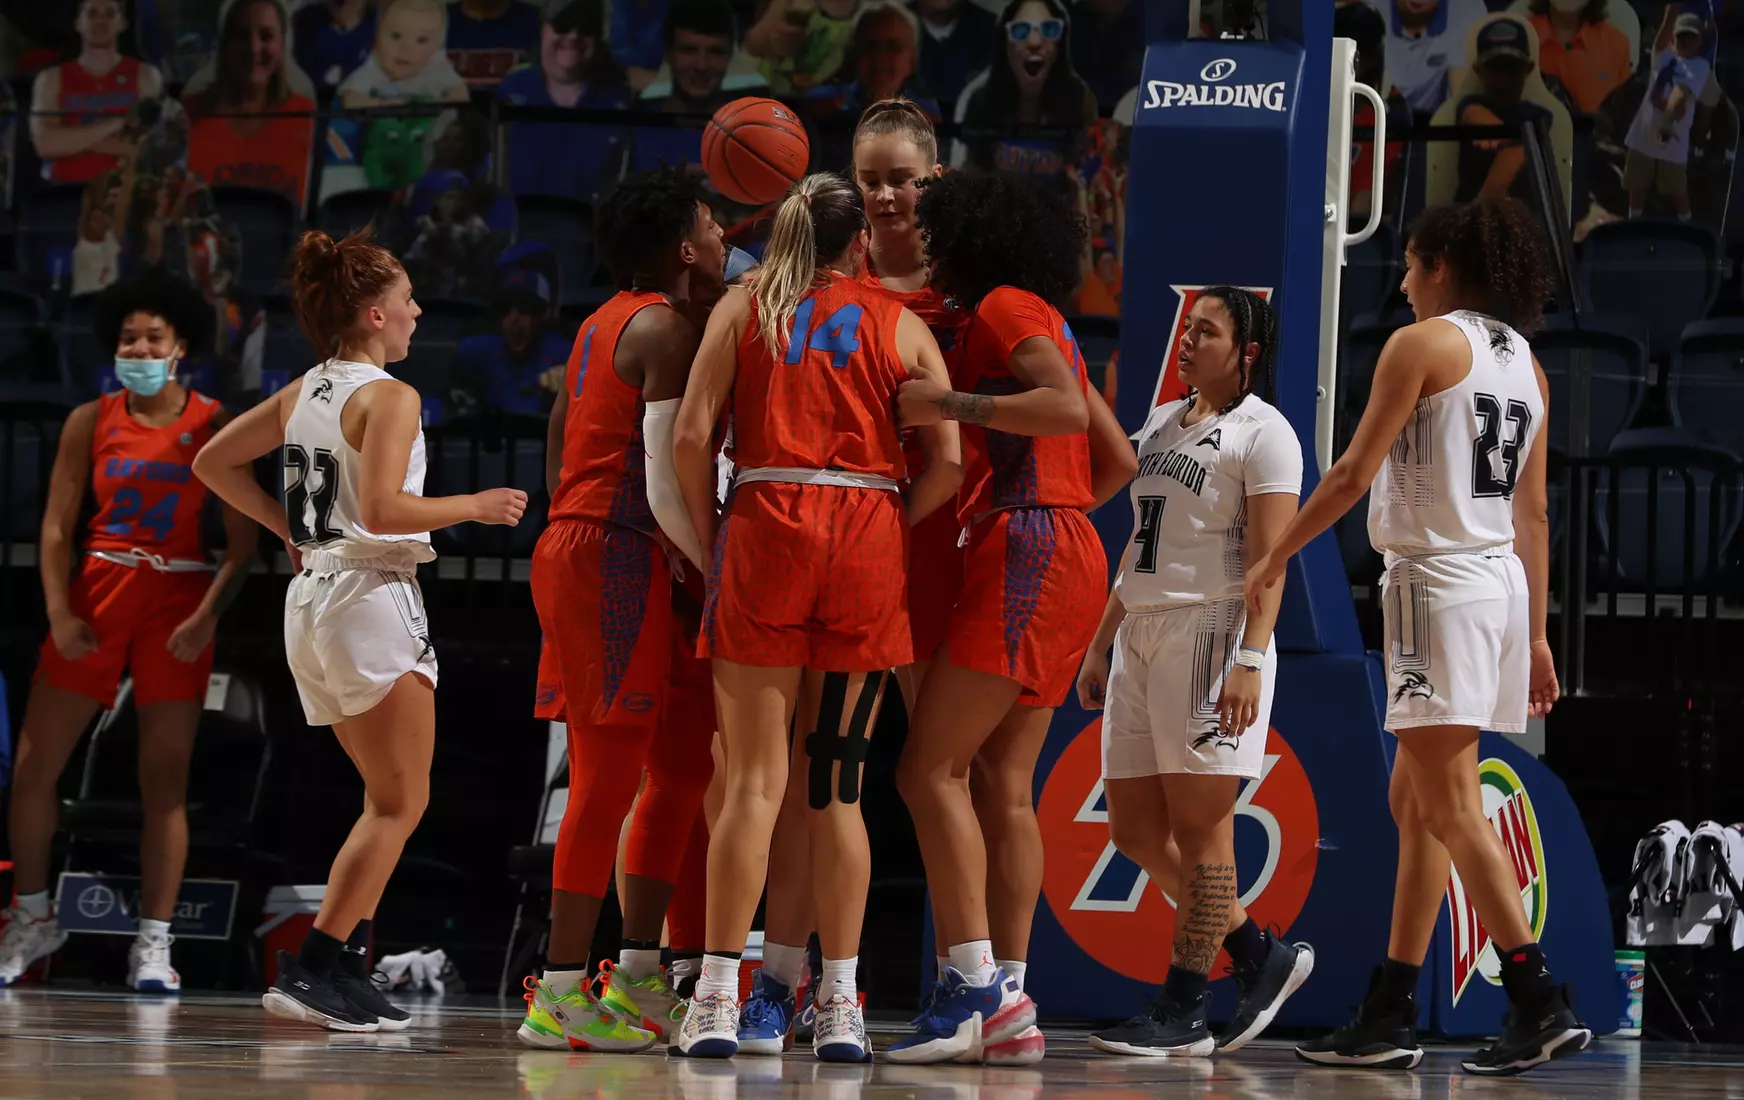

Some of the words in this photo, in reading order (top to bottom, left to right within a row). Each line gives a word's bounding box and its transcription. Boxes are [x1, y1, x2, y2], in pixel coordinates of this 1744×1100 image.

[1144, 80, 1286, 112] SPALDING
[574, 324, 597, 398] 1
[785, 298, 864, 369] 14
[1156, 449, 1207, 497] FLORIDA
[1472, 392, 1532, 501] 23
[105, 487, 181, 541] 24
[284, 444, 345, 547] 22
[1134, 495, 1167, 573] 4
